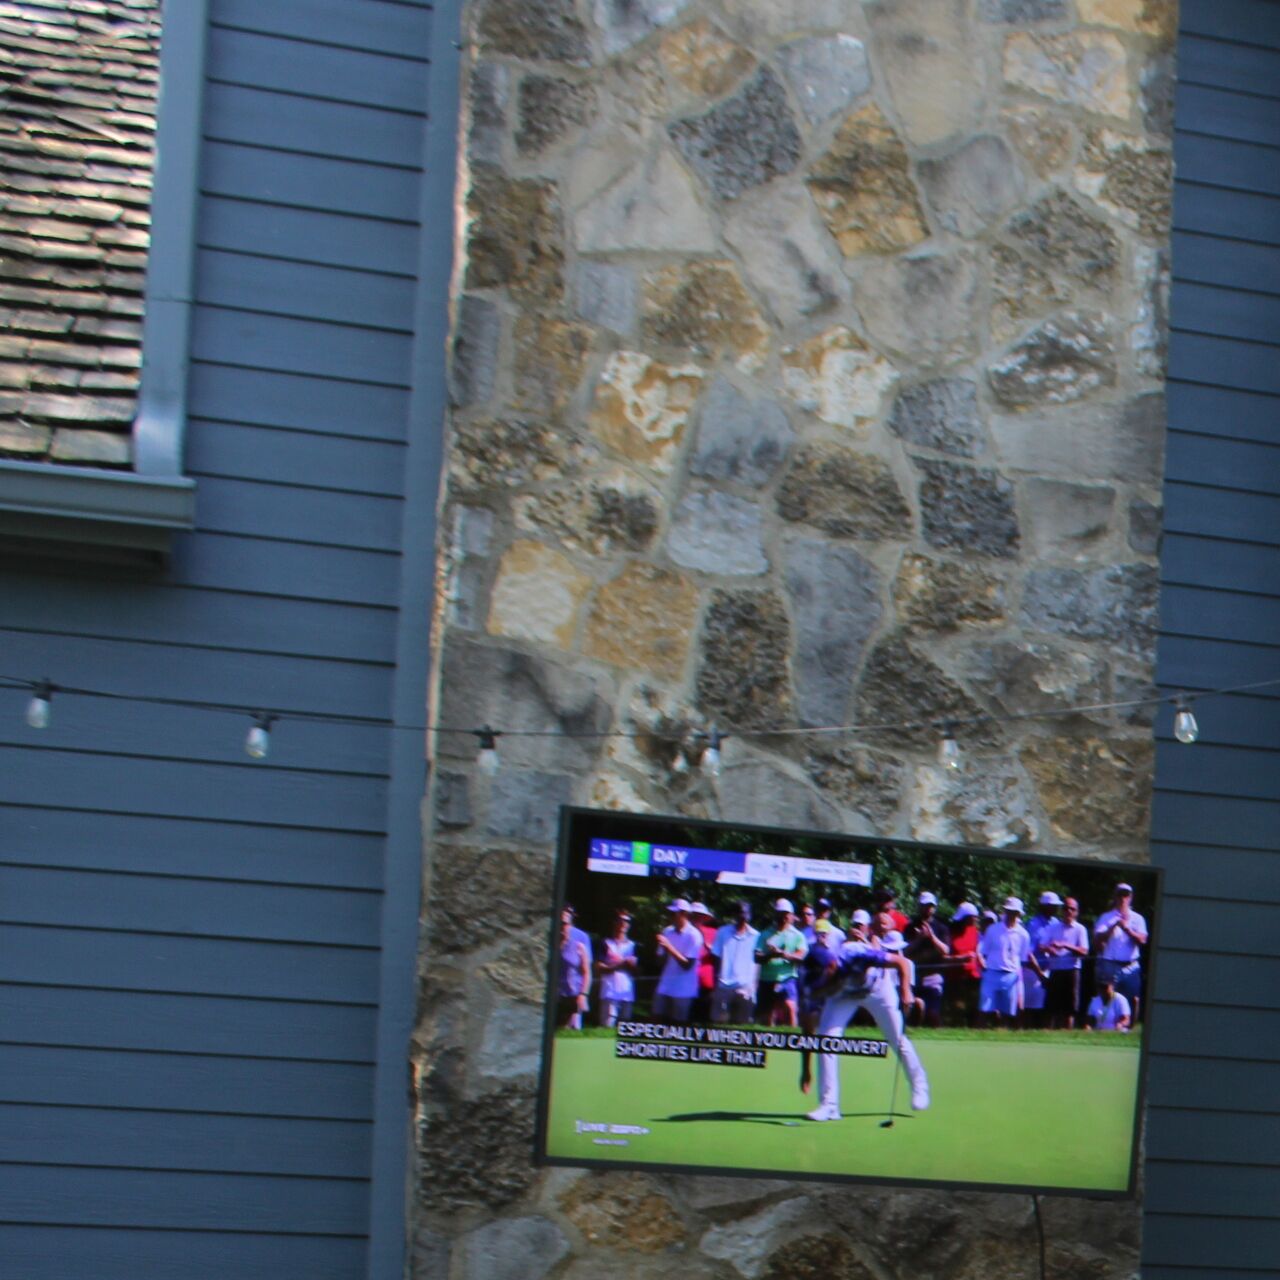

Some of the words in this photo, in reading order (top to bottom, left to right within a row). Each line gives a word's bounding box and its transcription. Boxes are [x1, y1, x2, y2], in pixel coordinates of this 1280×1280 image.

[652, 848, 689, 865] DAY
[617, 1021, 704, 1040] ESPECIALLY
[706, 1029, 753, 1045] WHEN
[755, 1032, 786, 1047] YOU
[787, 1034, 819, 1050] CAN
[821, 1037, 888, 1055] CONVERT
[616, 1041, 689, 1060] SHORTIES
[690, 1047, 722, 1062] LIKE
[724, 1049, 765, 1066] THAT.
